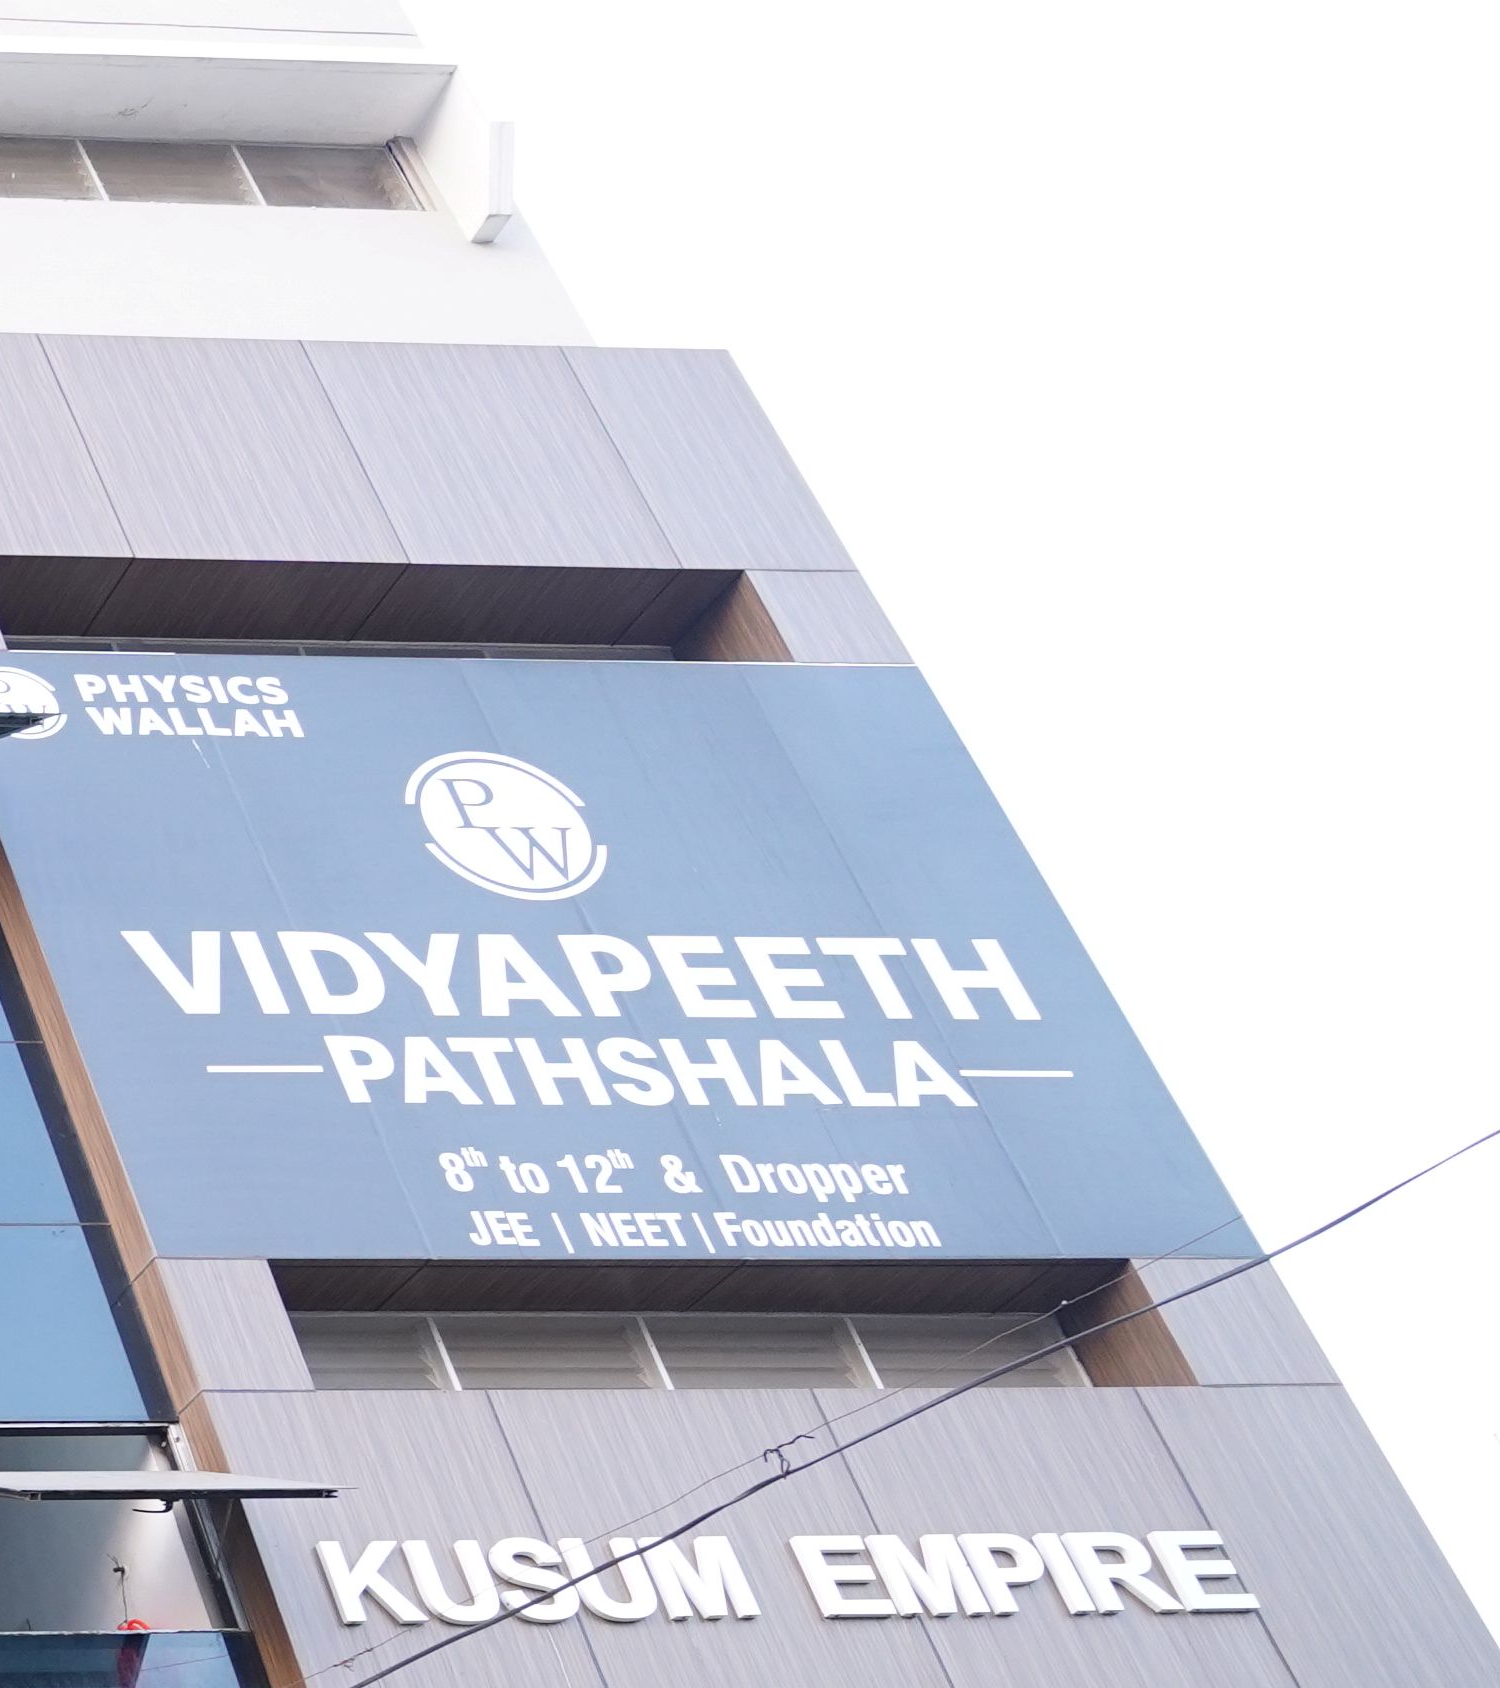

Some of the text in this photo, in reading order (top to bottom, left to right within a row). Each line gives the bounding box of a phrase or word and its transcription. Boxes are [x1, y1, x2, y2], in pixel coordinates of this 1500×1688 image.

[74, 675, 288, 704] PHYSICS
[86, 707, 304, 737] WALLAH
[121, 931, 1040, 1020] VIDYAPEETH
[323, 1036, 977, 1107] PATHSHALA
[439, 1147, 908, 1202] 8th to 12th & Dropper
[470, 1211, 941, 1247] JEE NEET Foundation
[315, 1530, 1259, 1628] KUSUM EMPIRE
